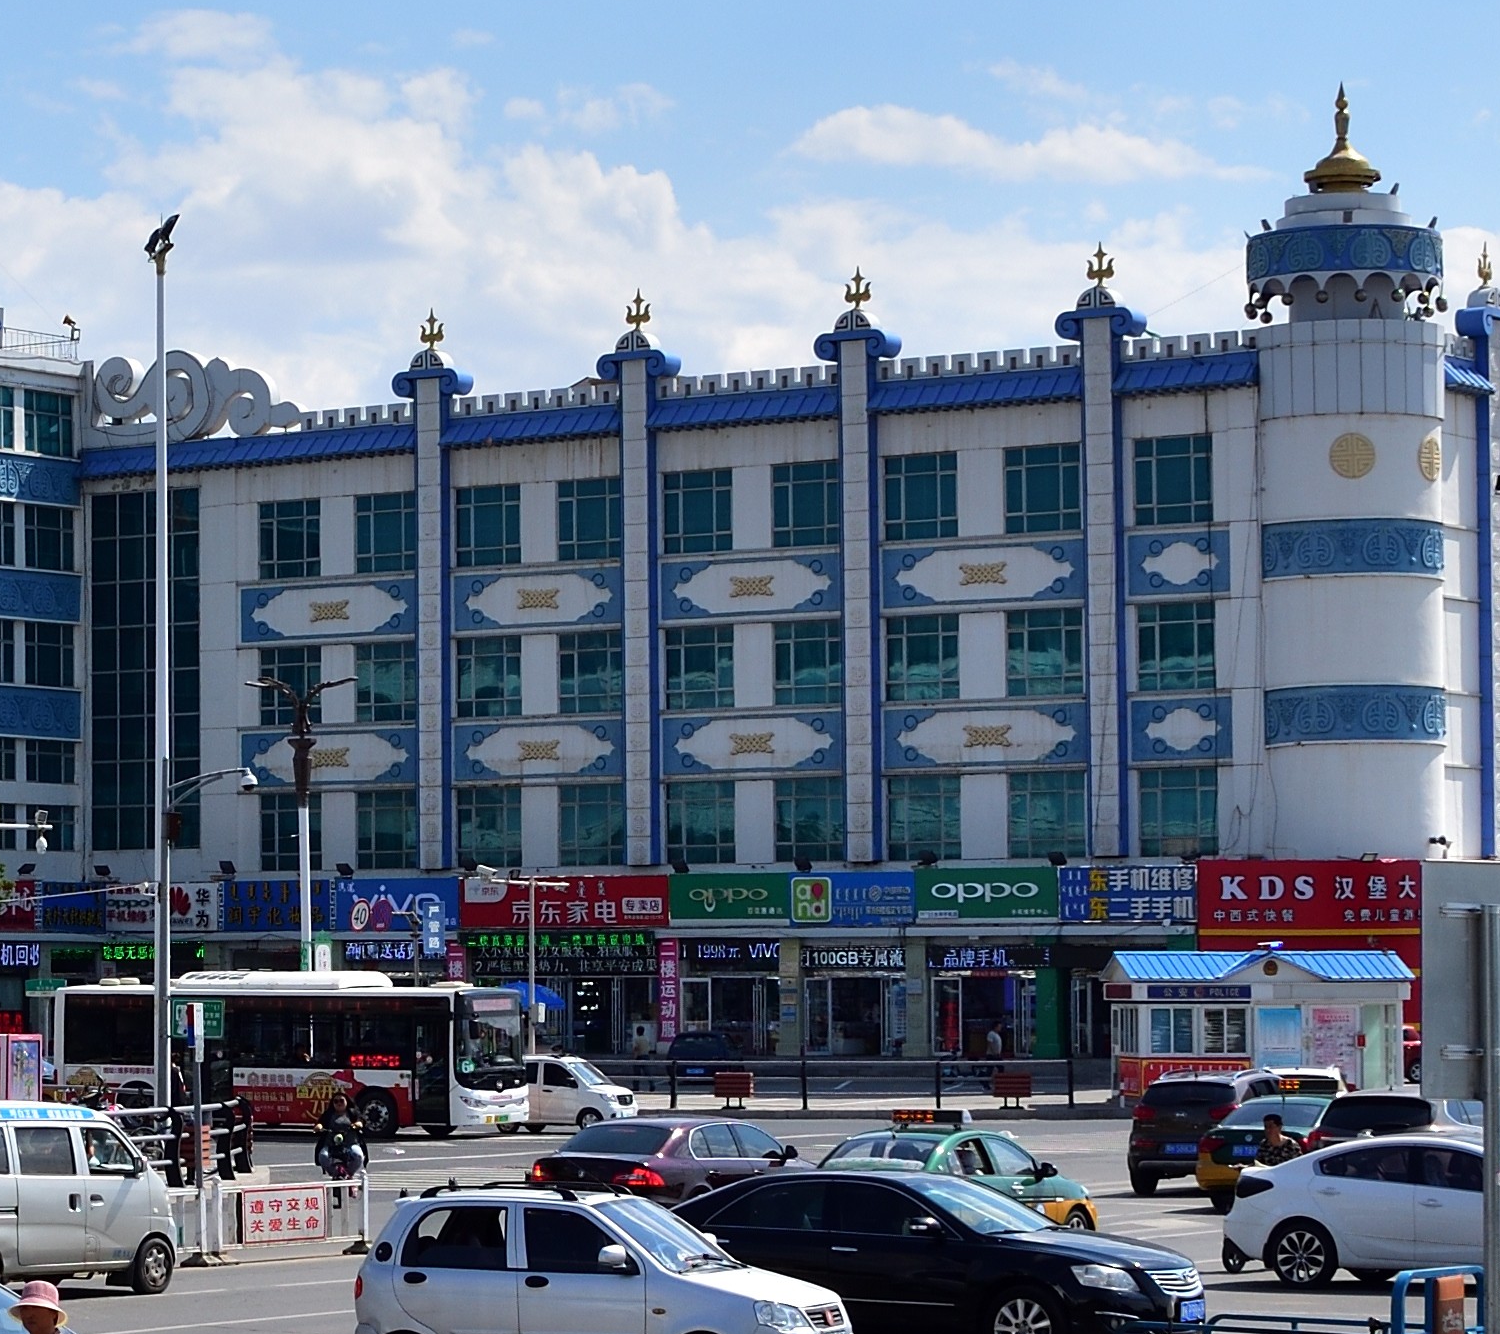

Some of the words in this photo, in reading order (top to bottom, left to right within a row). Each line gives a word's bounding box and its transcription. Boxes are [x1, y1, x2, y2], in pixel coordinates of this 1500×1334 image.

[930, 881, 1040, 904] oppo
[353, 906, 367, 926] 40
[511, 899, 617, 924] 京东家电
[1213, 909, 1295, 923] 中西式快餐
[660, 939, 676, 1039] 二楼运动服
[1209, 988, 1240, 997] POLICE
[250, 1196, 319, 1214] 遵守交规
[250, 1216, 319, 1234] 关爱生命
